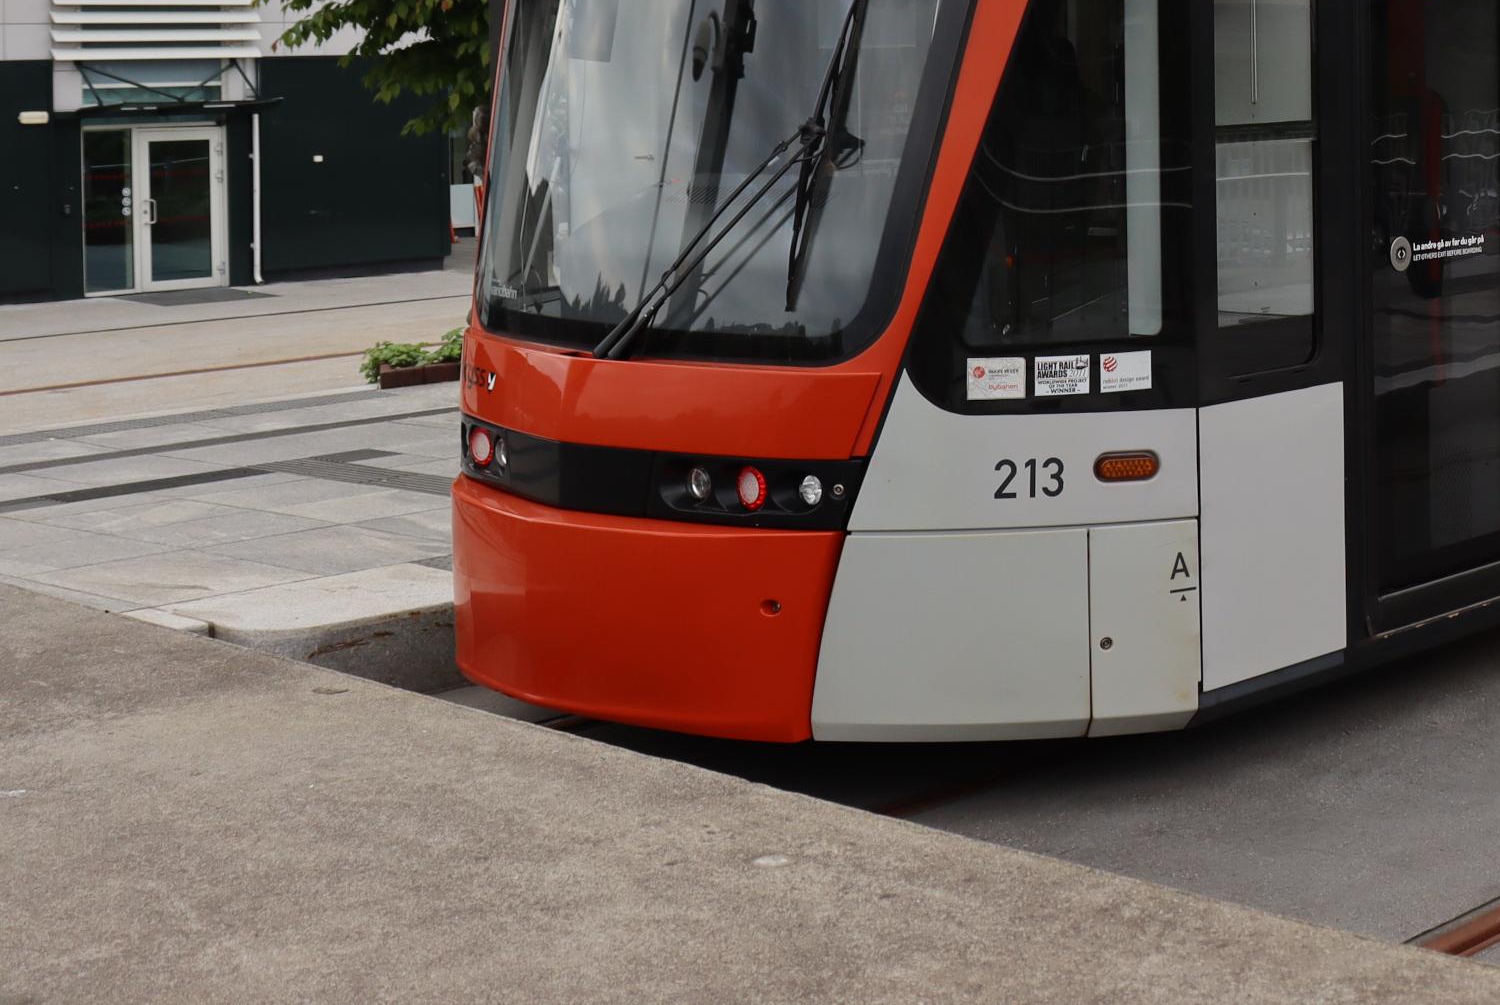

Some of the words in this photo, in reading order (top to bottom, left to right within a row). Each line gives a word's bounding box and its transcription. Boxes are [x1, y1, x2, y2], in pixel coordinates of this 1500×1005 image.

[1421, 240, 1437, 251] andre
[1445, 240, 1452, 248] av
[1460, 236, 1468, 246] du
[1477, 233, 1485, 245] på
[1413, 253, 1421, 262] LET
[1421, 251, 1438, 260] OTHERS
[1437, 249, 1447, 258] EXIT
[1447, 248, 1462, 257] BEFORE
[1037, 362, 1057, 371] LIGHT
[1058, 361, 1075, 370] RAIL
[1037, 370, 1068, 379] AWARDS
[993, 457, 1065, 499] 213
[1170, 552, 1191, 580] A
